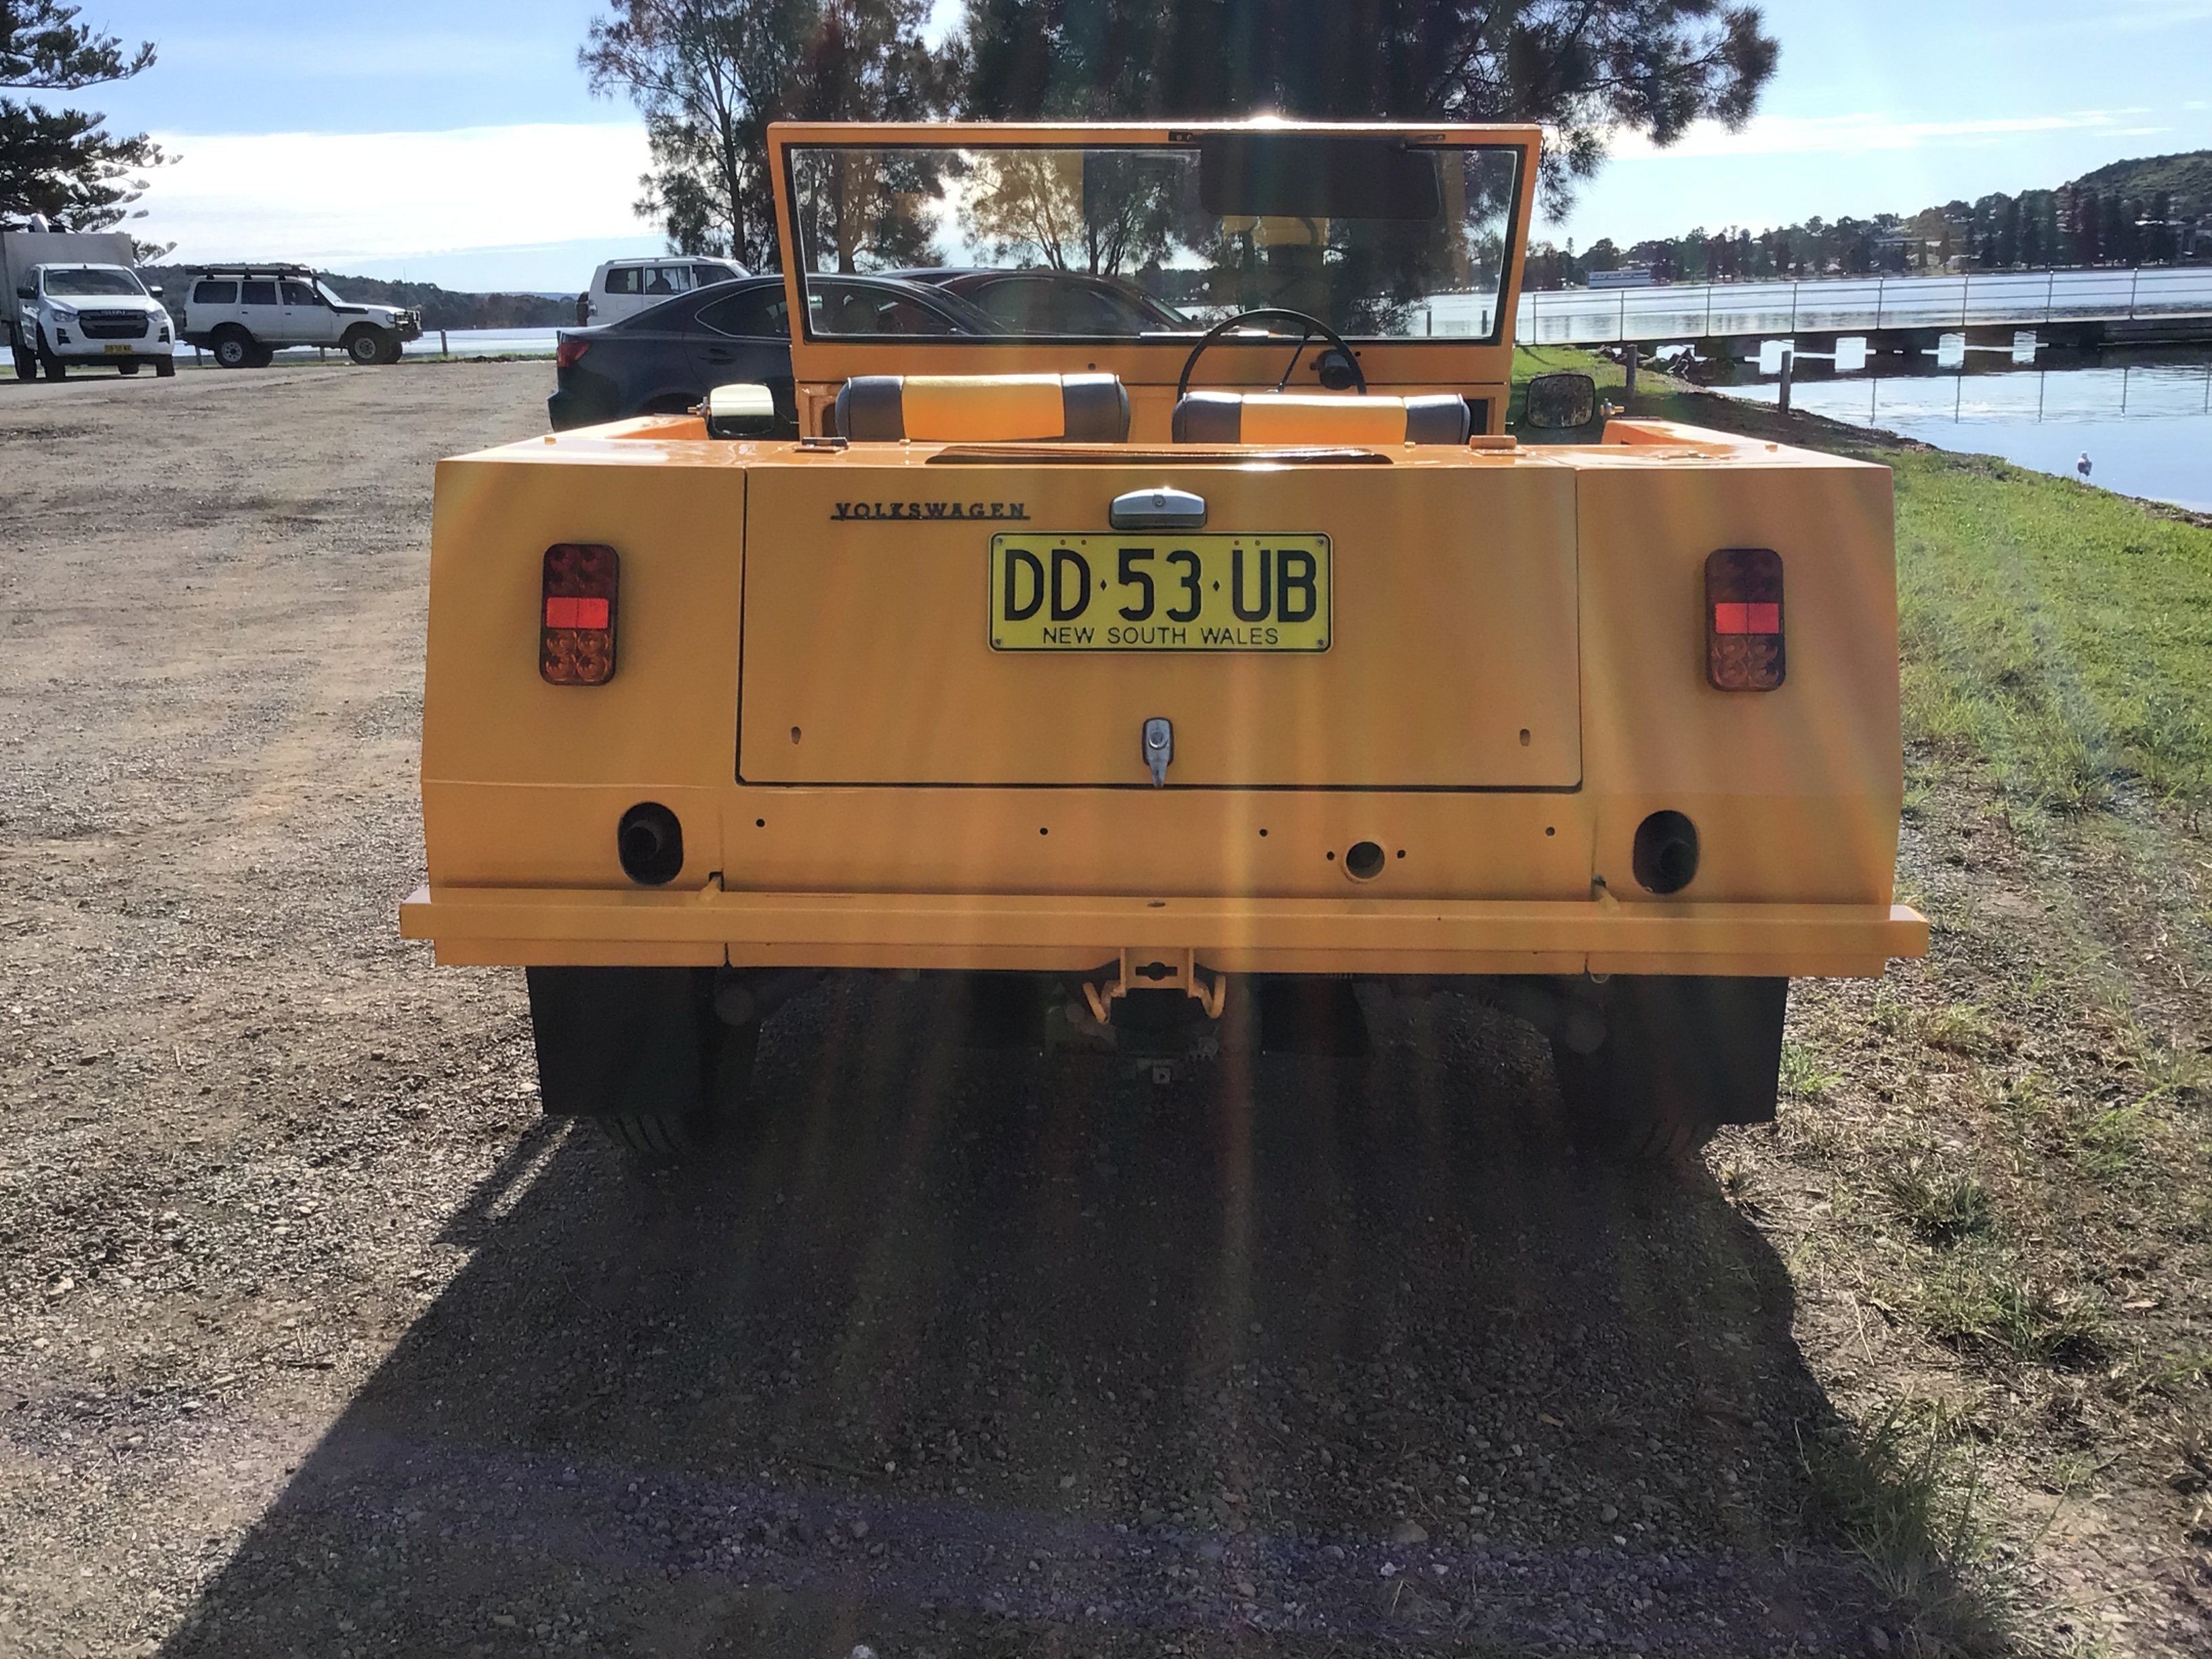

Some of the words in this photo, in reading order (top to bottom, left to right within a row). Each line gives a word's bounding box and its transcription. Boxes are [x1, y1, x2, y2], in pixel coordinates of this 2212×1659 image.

[835, 502, 1025, 519] VOLKSWAGEN
[1042, 627, 1095, 645] NEW
[1107, 627, 1186, 645] SOUTH
[1201, 627, 1279, 645] WALES
